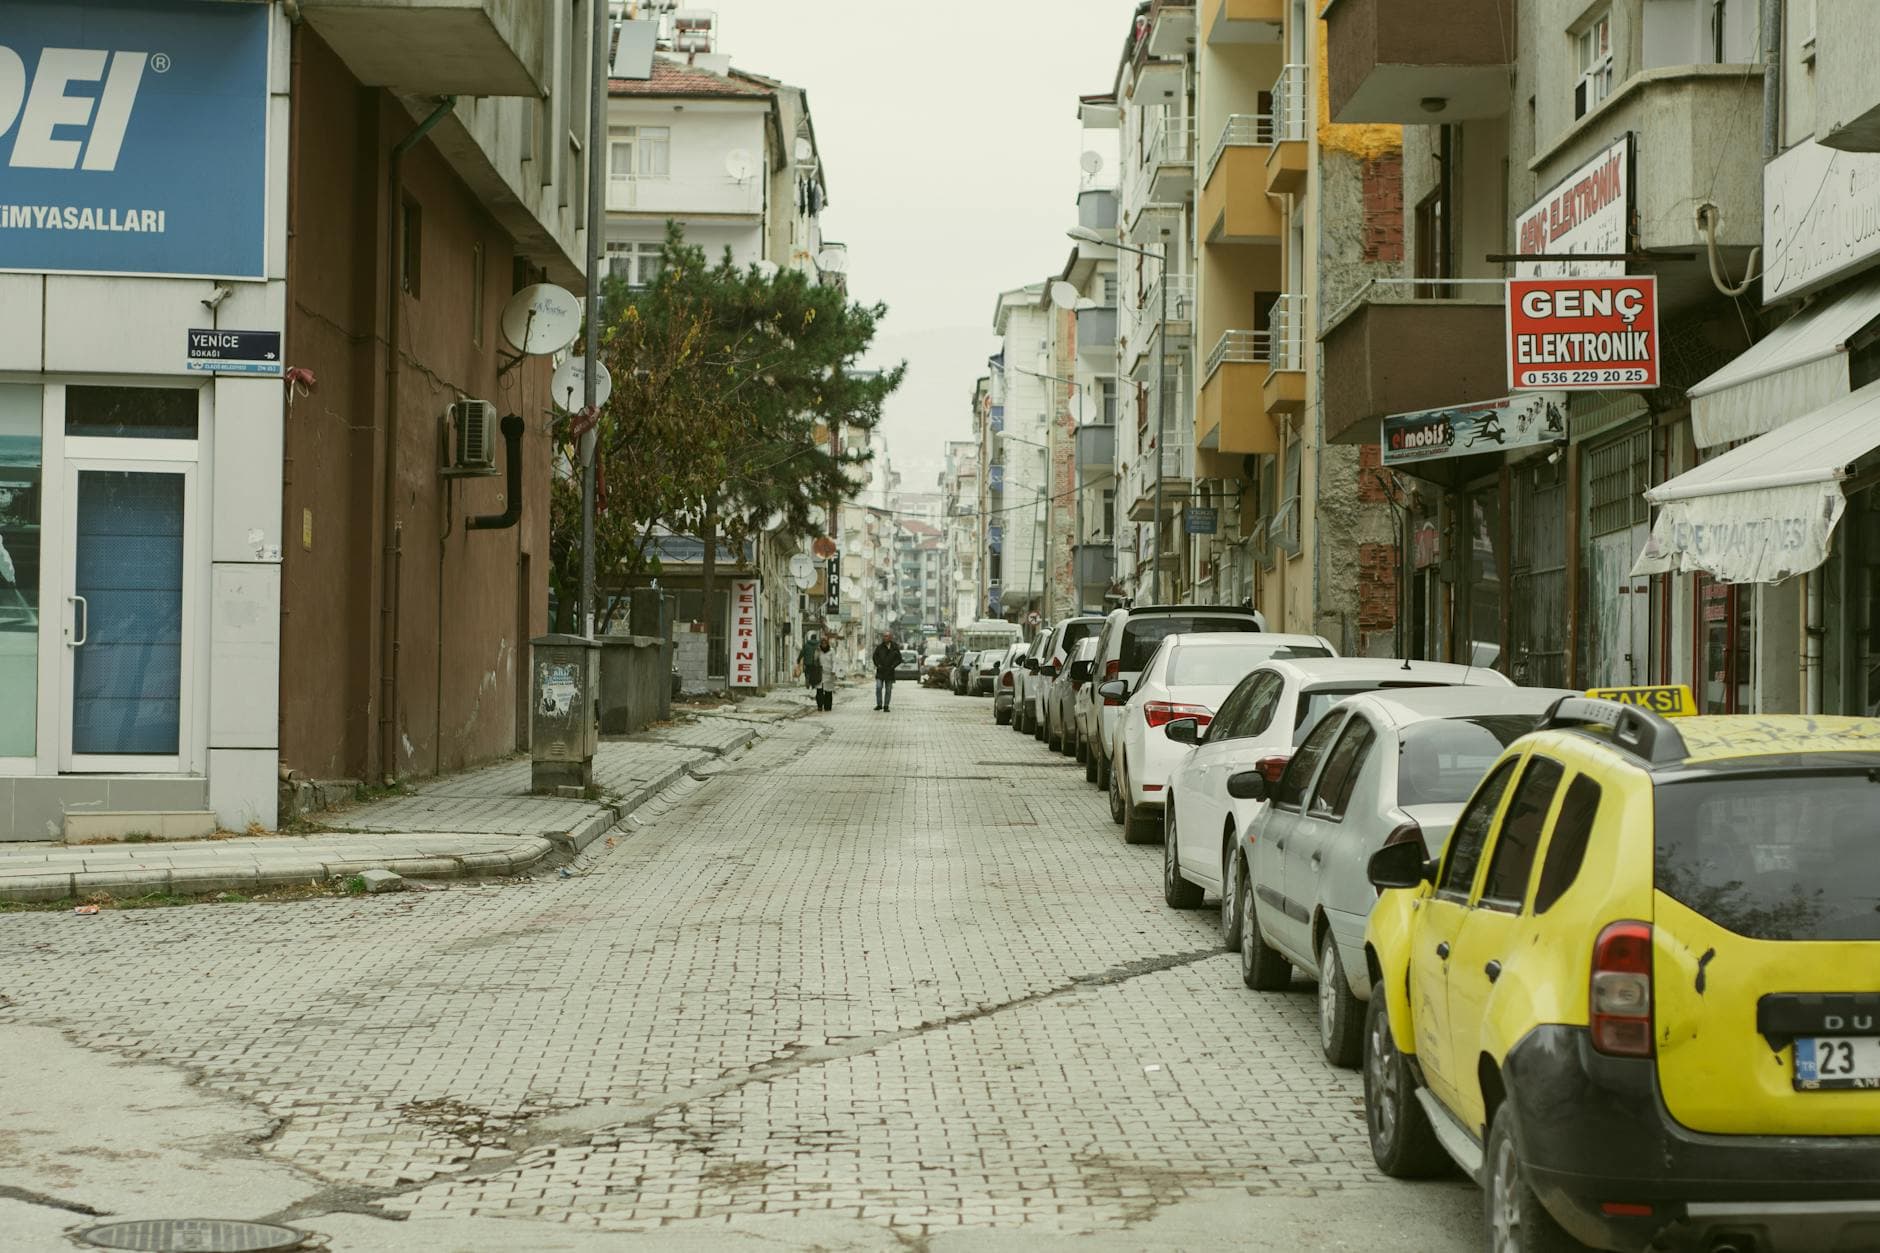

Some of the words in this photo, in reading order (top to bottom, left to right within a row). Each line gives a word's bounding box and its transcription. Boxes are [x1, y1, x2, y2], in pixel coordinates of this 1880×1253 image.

[1550, 149, 1622, 243] ELEKTRONİK
[1522, 288, 1644, 323] GENÇ
[191, 349, 220, 358] SOKAĞI
[192, 333, 239, 348] YENİCE
[1517, 324, 1650, 364] ELEKTRONİK
[1528, 373, 1537, 384] 0
[1541, 372, 1568, 384] 536
[1572, 371, 1599, 383] 229
[1603, 370, 1620, 382] 20
[1625, 370, 1643, 381] 25
[736, 584, 753, 683] VETERİNER
[1802, 1061, 1816, 1072] TR
[1819, 1041, 1855, 1075] 23
